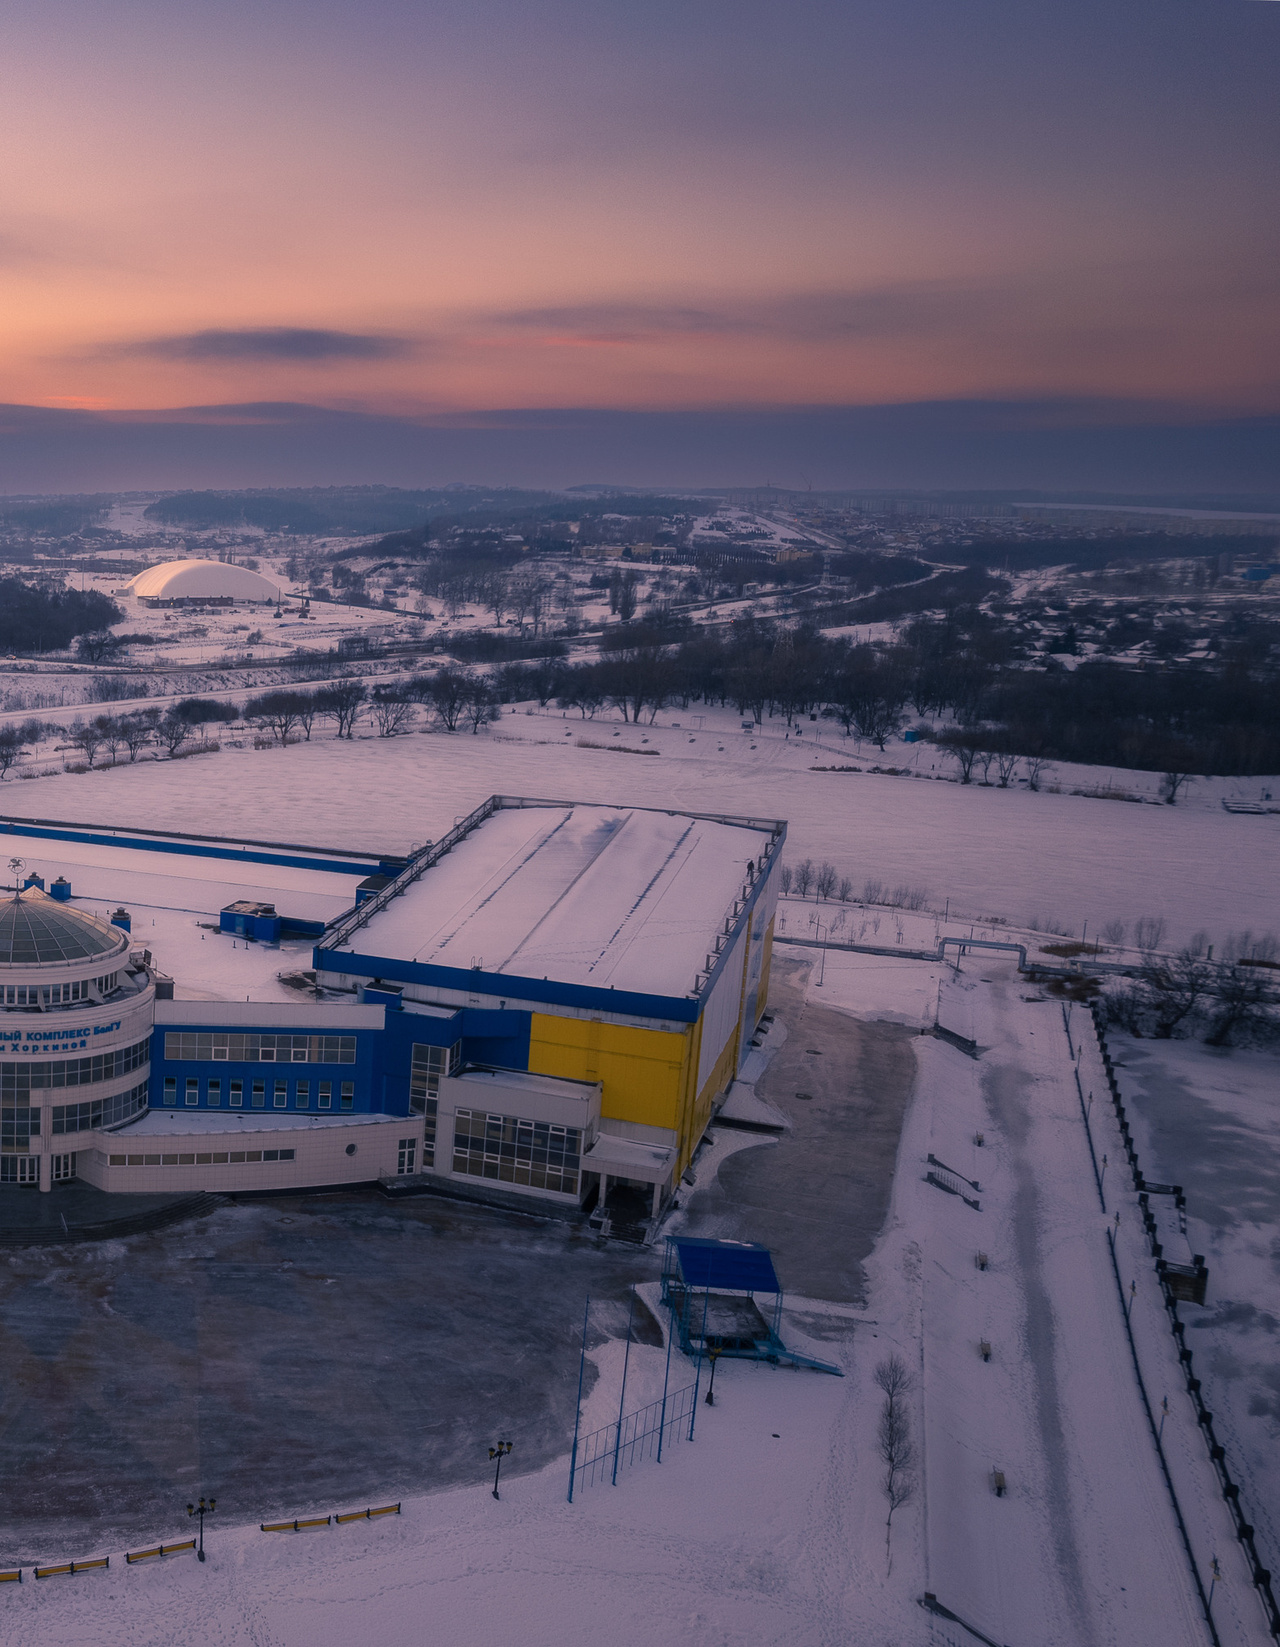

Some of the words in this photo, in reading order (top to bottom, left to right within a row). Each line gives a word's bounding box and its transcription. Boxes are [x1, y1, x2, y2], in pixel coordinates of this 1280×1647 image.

[26, 1028, 91, 1041] КОМПЛЕКС
[93, 1020, 121, 1035] БелГУ
[11, 1039, 86, 1053] Хоркиной
